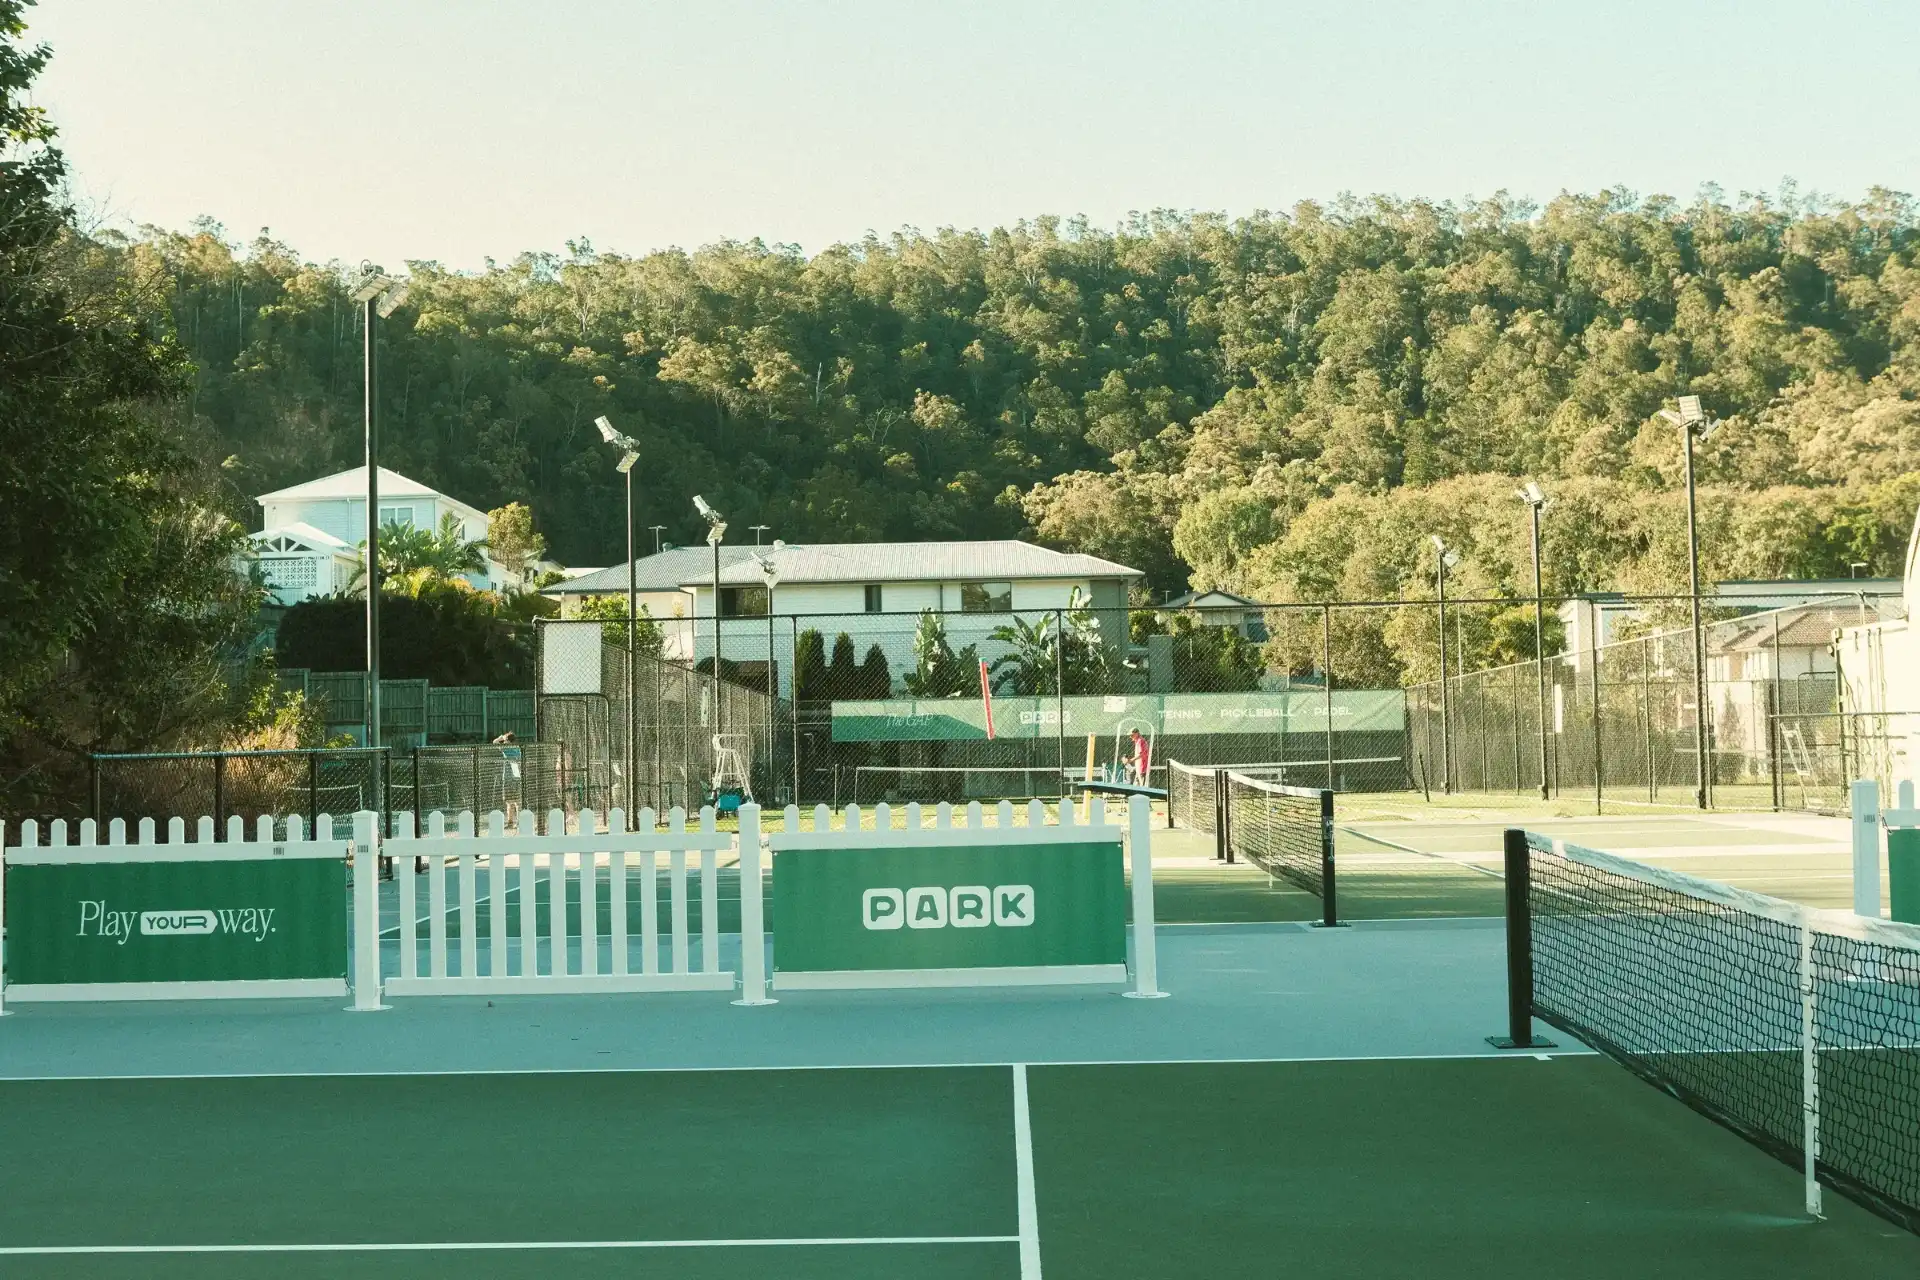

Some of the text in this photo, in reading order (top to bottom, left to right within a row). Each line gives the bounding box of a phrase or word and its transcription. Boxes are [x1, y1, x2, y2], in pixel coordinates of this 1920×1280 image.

[1220, 707, 1294, 718] PICKLEBALL
[1313, 707, 1353, 716] PADEL
[76, 899, 277, 946] Play YOUR way.
[868, 890, 1029, 925] PARK
